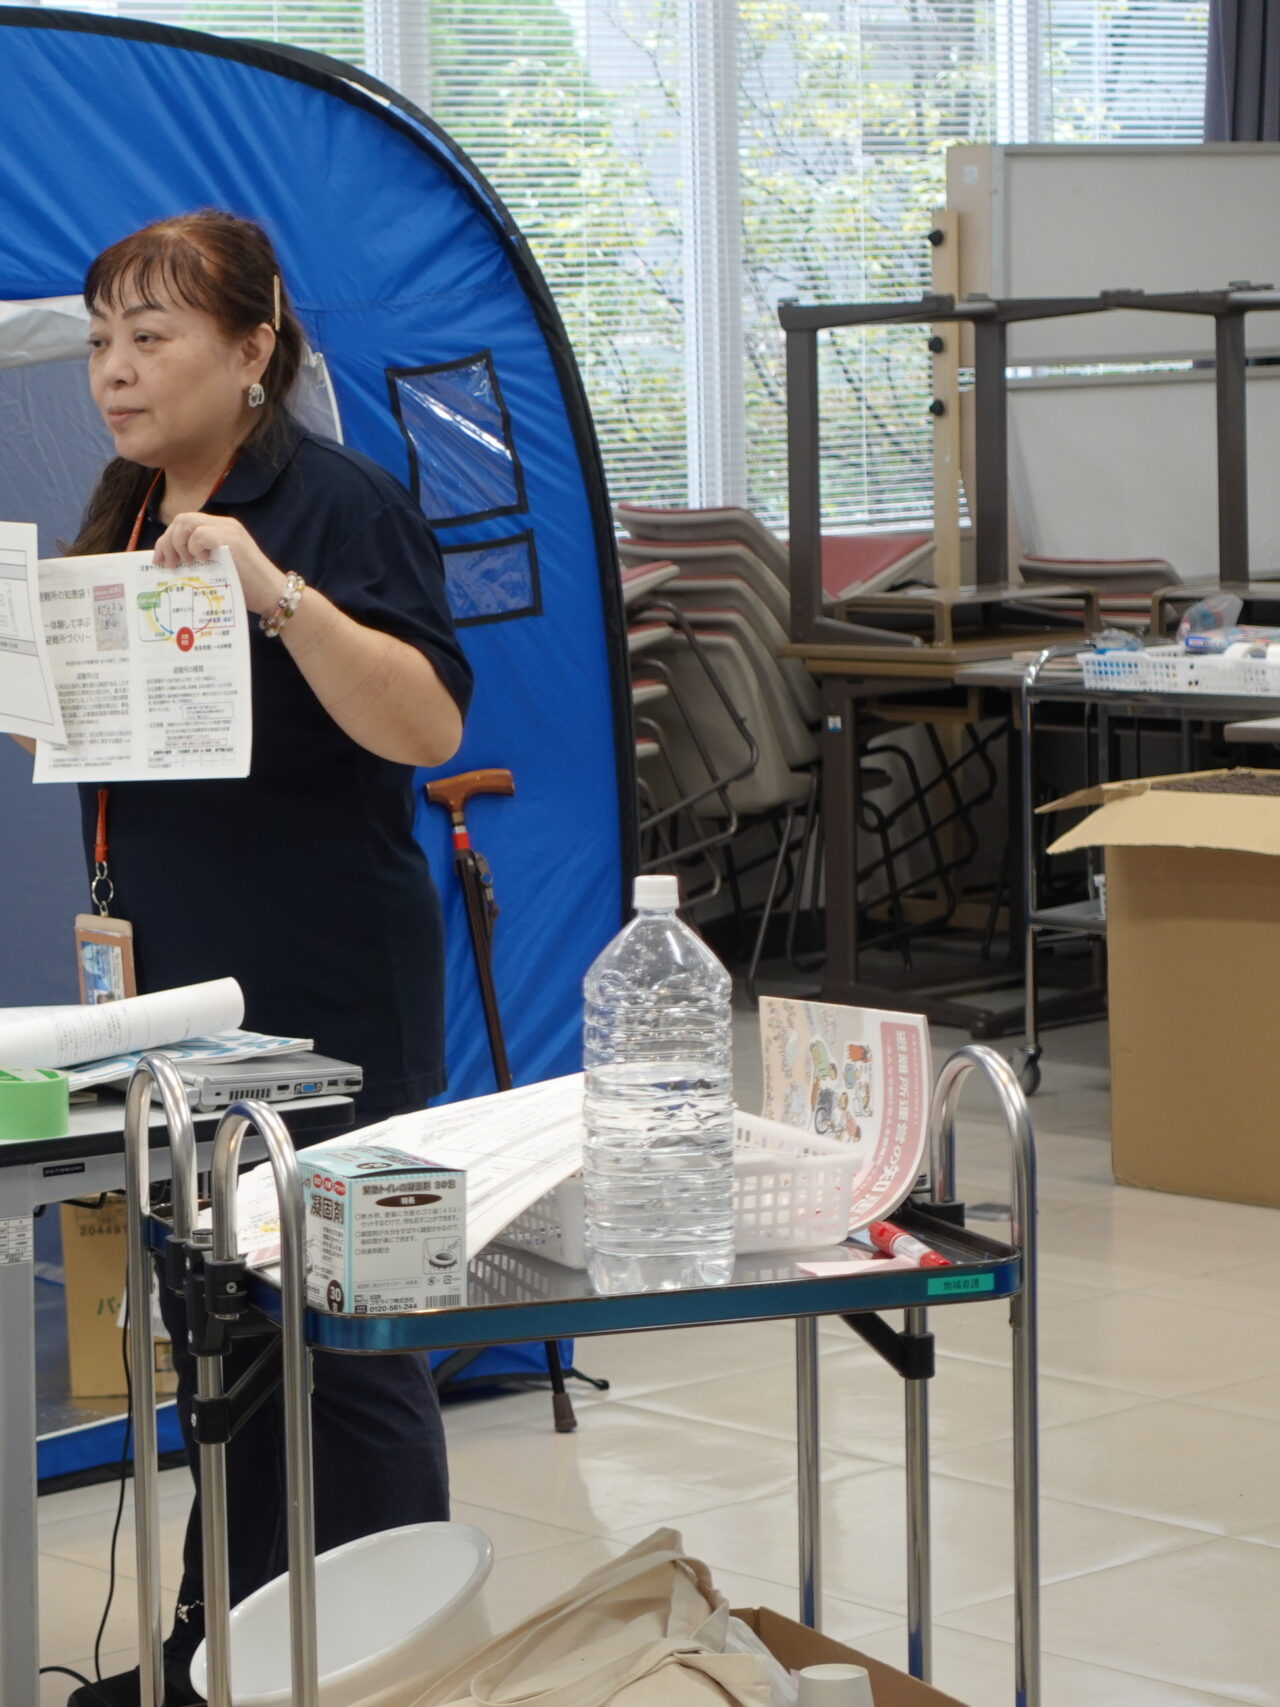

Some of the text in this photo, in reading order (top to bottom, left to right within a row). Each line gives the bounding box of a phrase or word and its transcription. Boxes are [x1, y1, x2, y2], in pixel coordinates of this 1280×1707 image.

[311, 1193, 344, 1225] 凝固剤
[330, 1286, 342, 1302] 30
[369, 1303, 418, 1313] 0120-561-244
